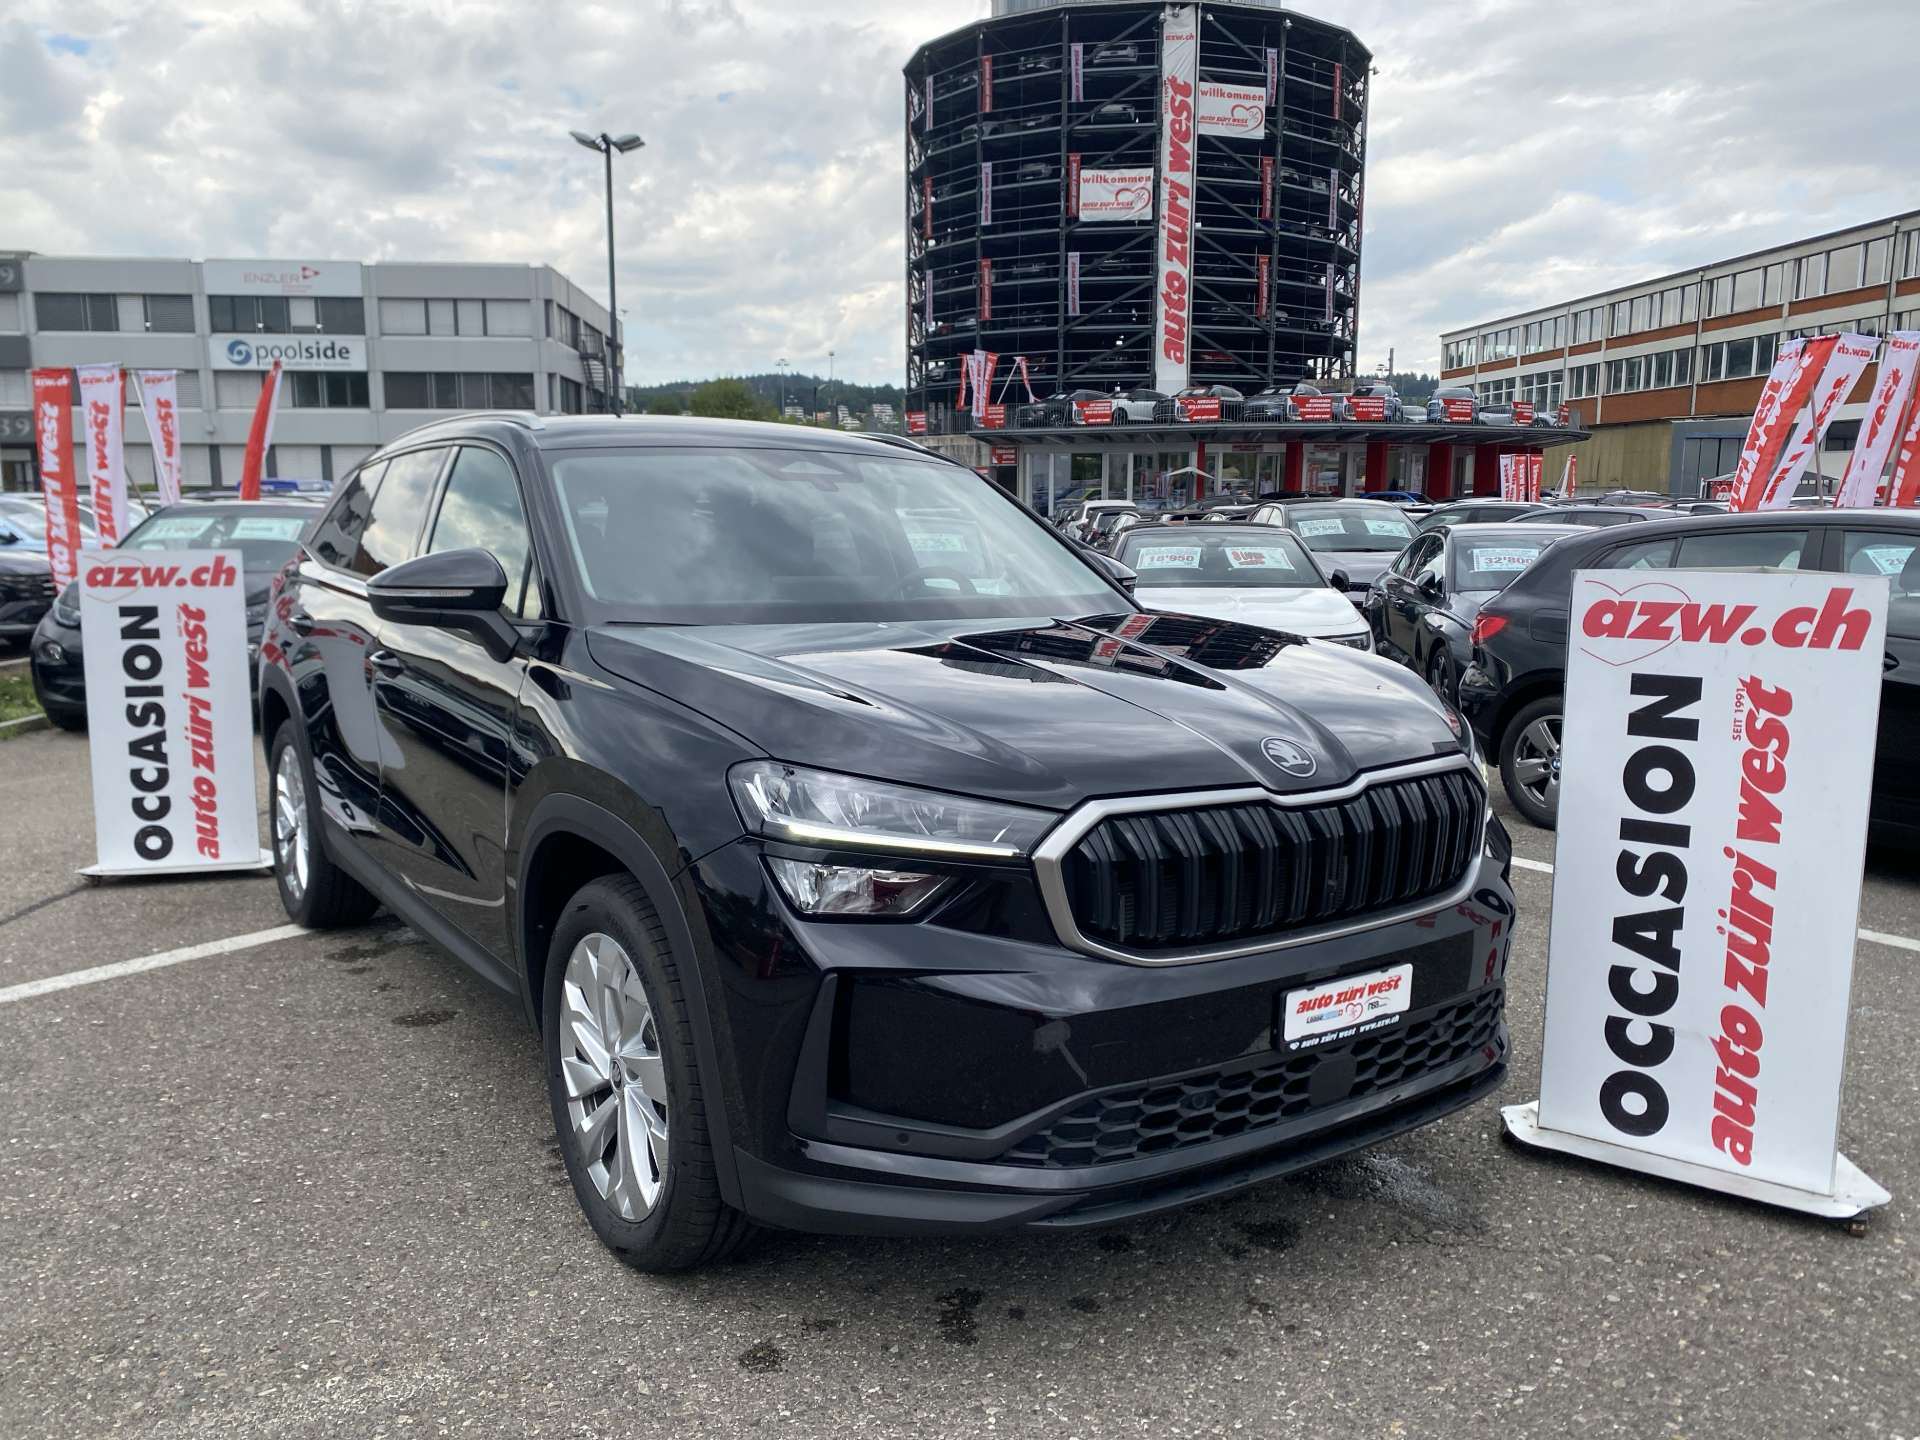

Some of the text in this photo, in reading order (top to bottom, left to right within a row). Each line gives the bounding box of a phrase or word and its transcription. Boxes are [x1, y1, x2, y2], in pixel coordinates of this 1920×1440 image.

[1200, 87, 1264, 102] willkommen
[1081, 173, 1152, 185] willkommen
[1160, 75, 1192, 365] auto züri west
[256, 340, 350, 366] poolside
[40, 400, 60, 473] west
[86, 555, 237, 588] azw.ch
[1582, 587, 1872, 650] azw.ch
[118, 605, 174, 861] OCCASION
[177, 602, 220, 860] auto züri west
[1732, 687, 1746, 741] SEIT 1991
[1599, 672, 1704, 1137] OCCASION
[1710, 674, 1794, 1167] auto züri west
[1296, 992, 1334, 1015] auto
[1334, 982, 1368, 1006] züri
[1367, 974, 1403, 996] west
[1300, 1037, 1320, 1049] auto
[1320, 1030, 1338, 1044] züri
[1338, 1026, 1357, 1039] west
[1359, 1014, 1400, 1034] www.azw.ch
